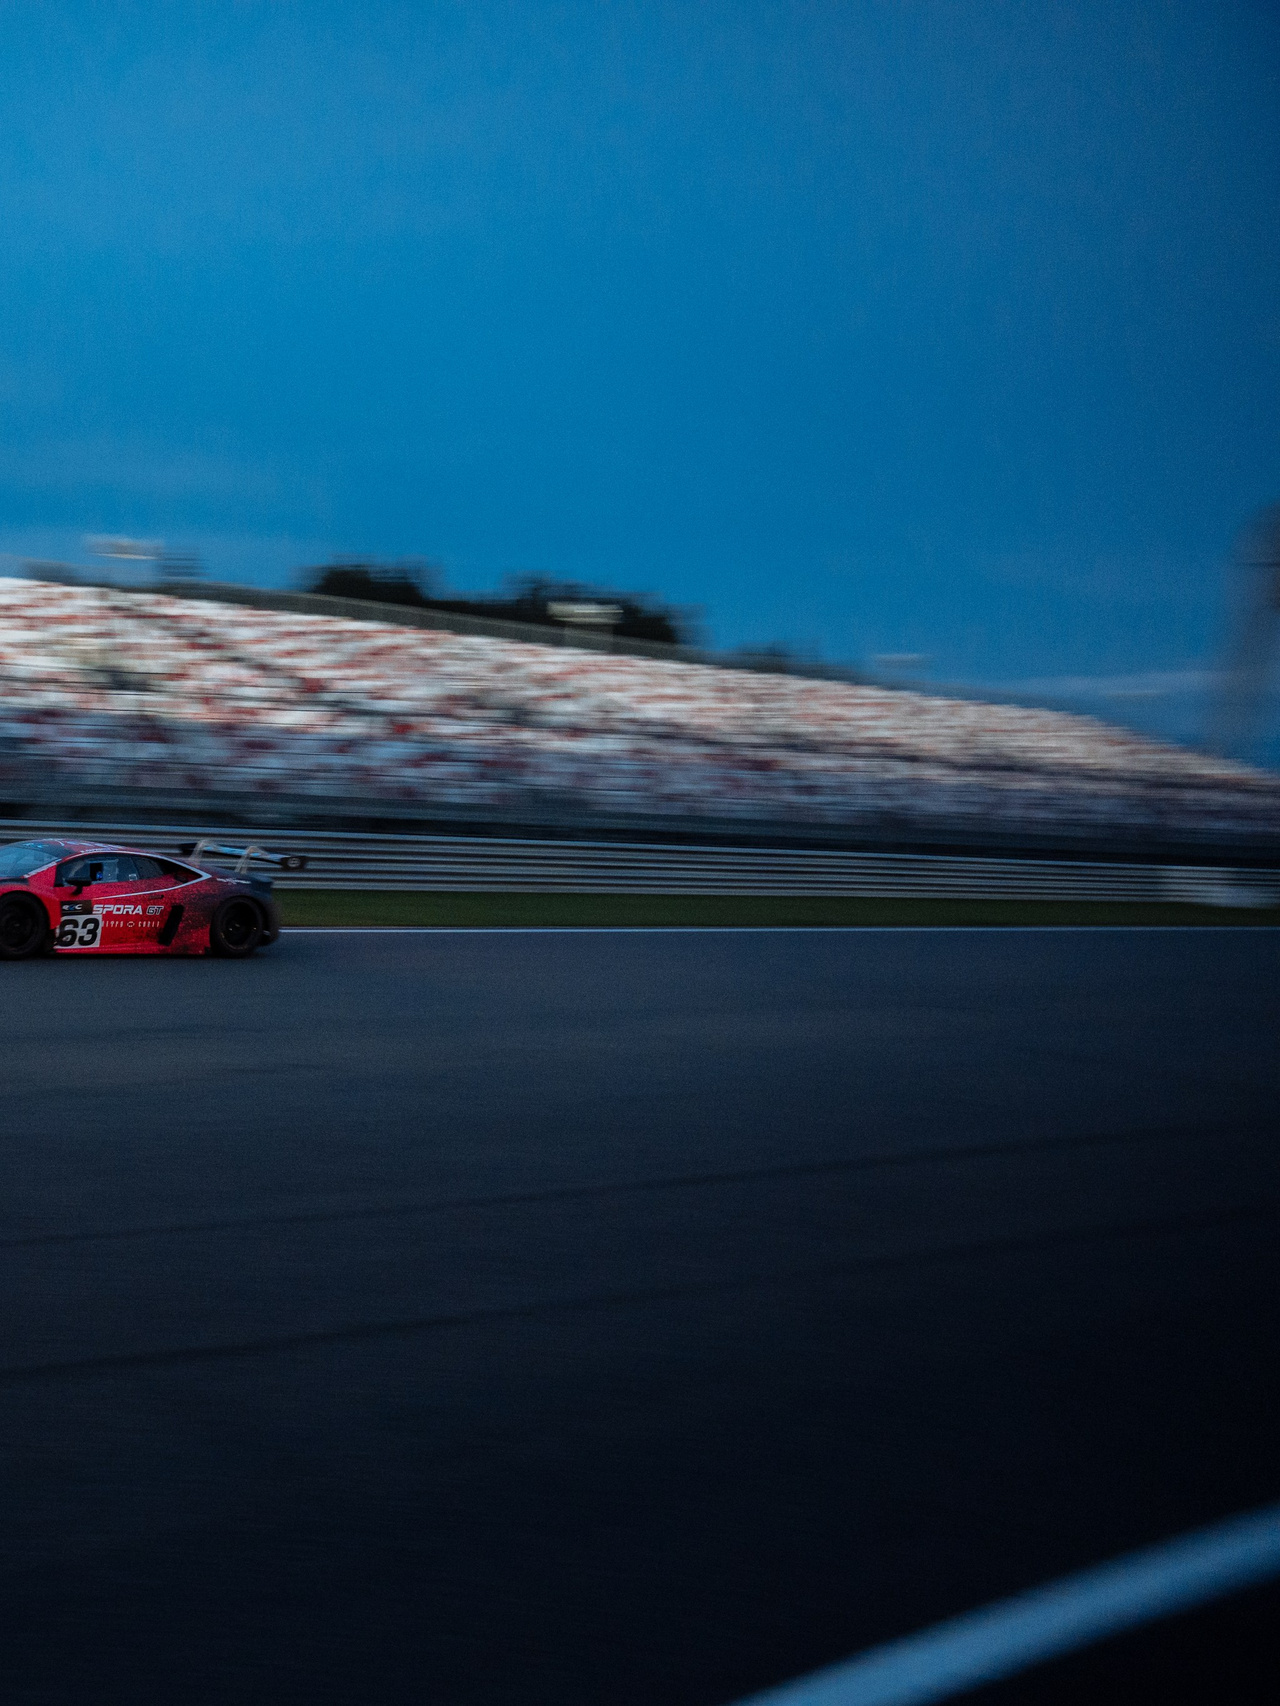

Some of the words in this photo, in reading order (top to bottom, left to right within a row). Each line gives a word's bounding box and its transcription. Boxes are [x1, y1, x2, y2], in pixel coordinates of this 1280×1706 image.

[92, 904, 143, 915] SPORA
[146, 905, 165, 916] GT
[58, 917, 100, 947] 63
